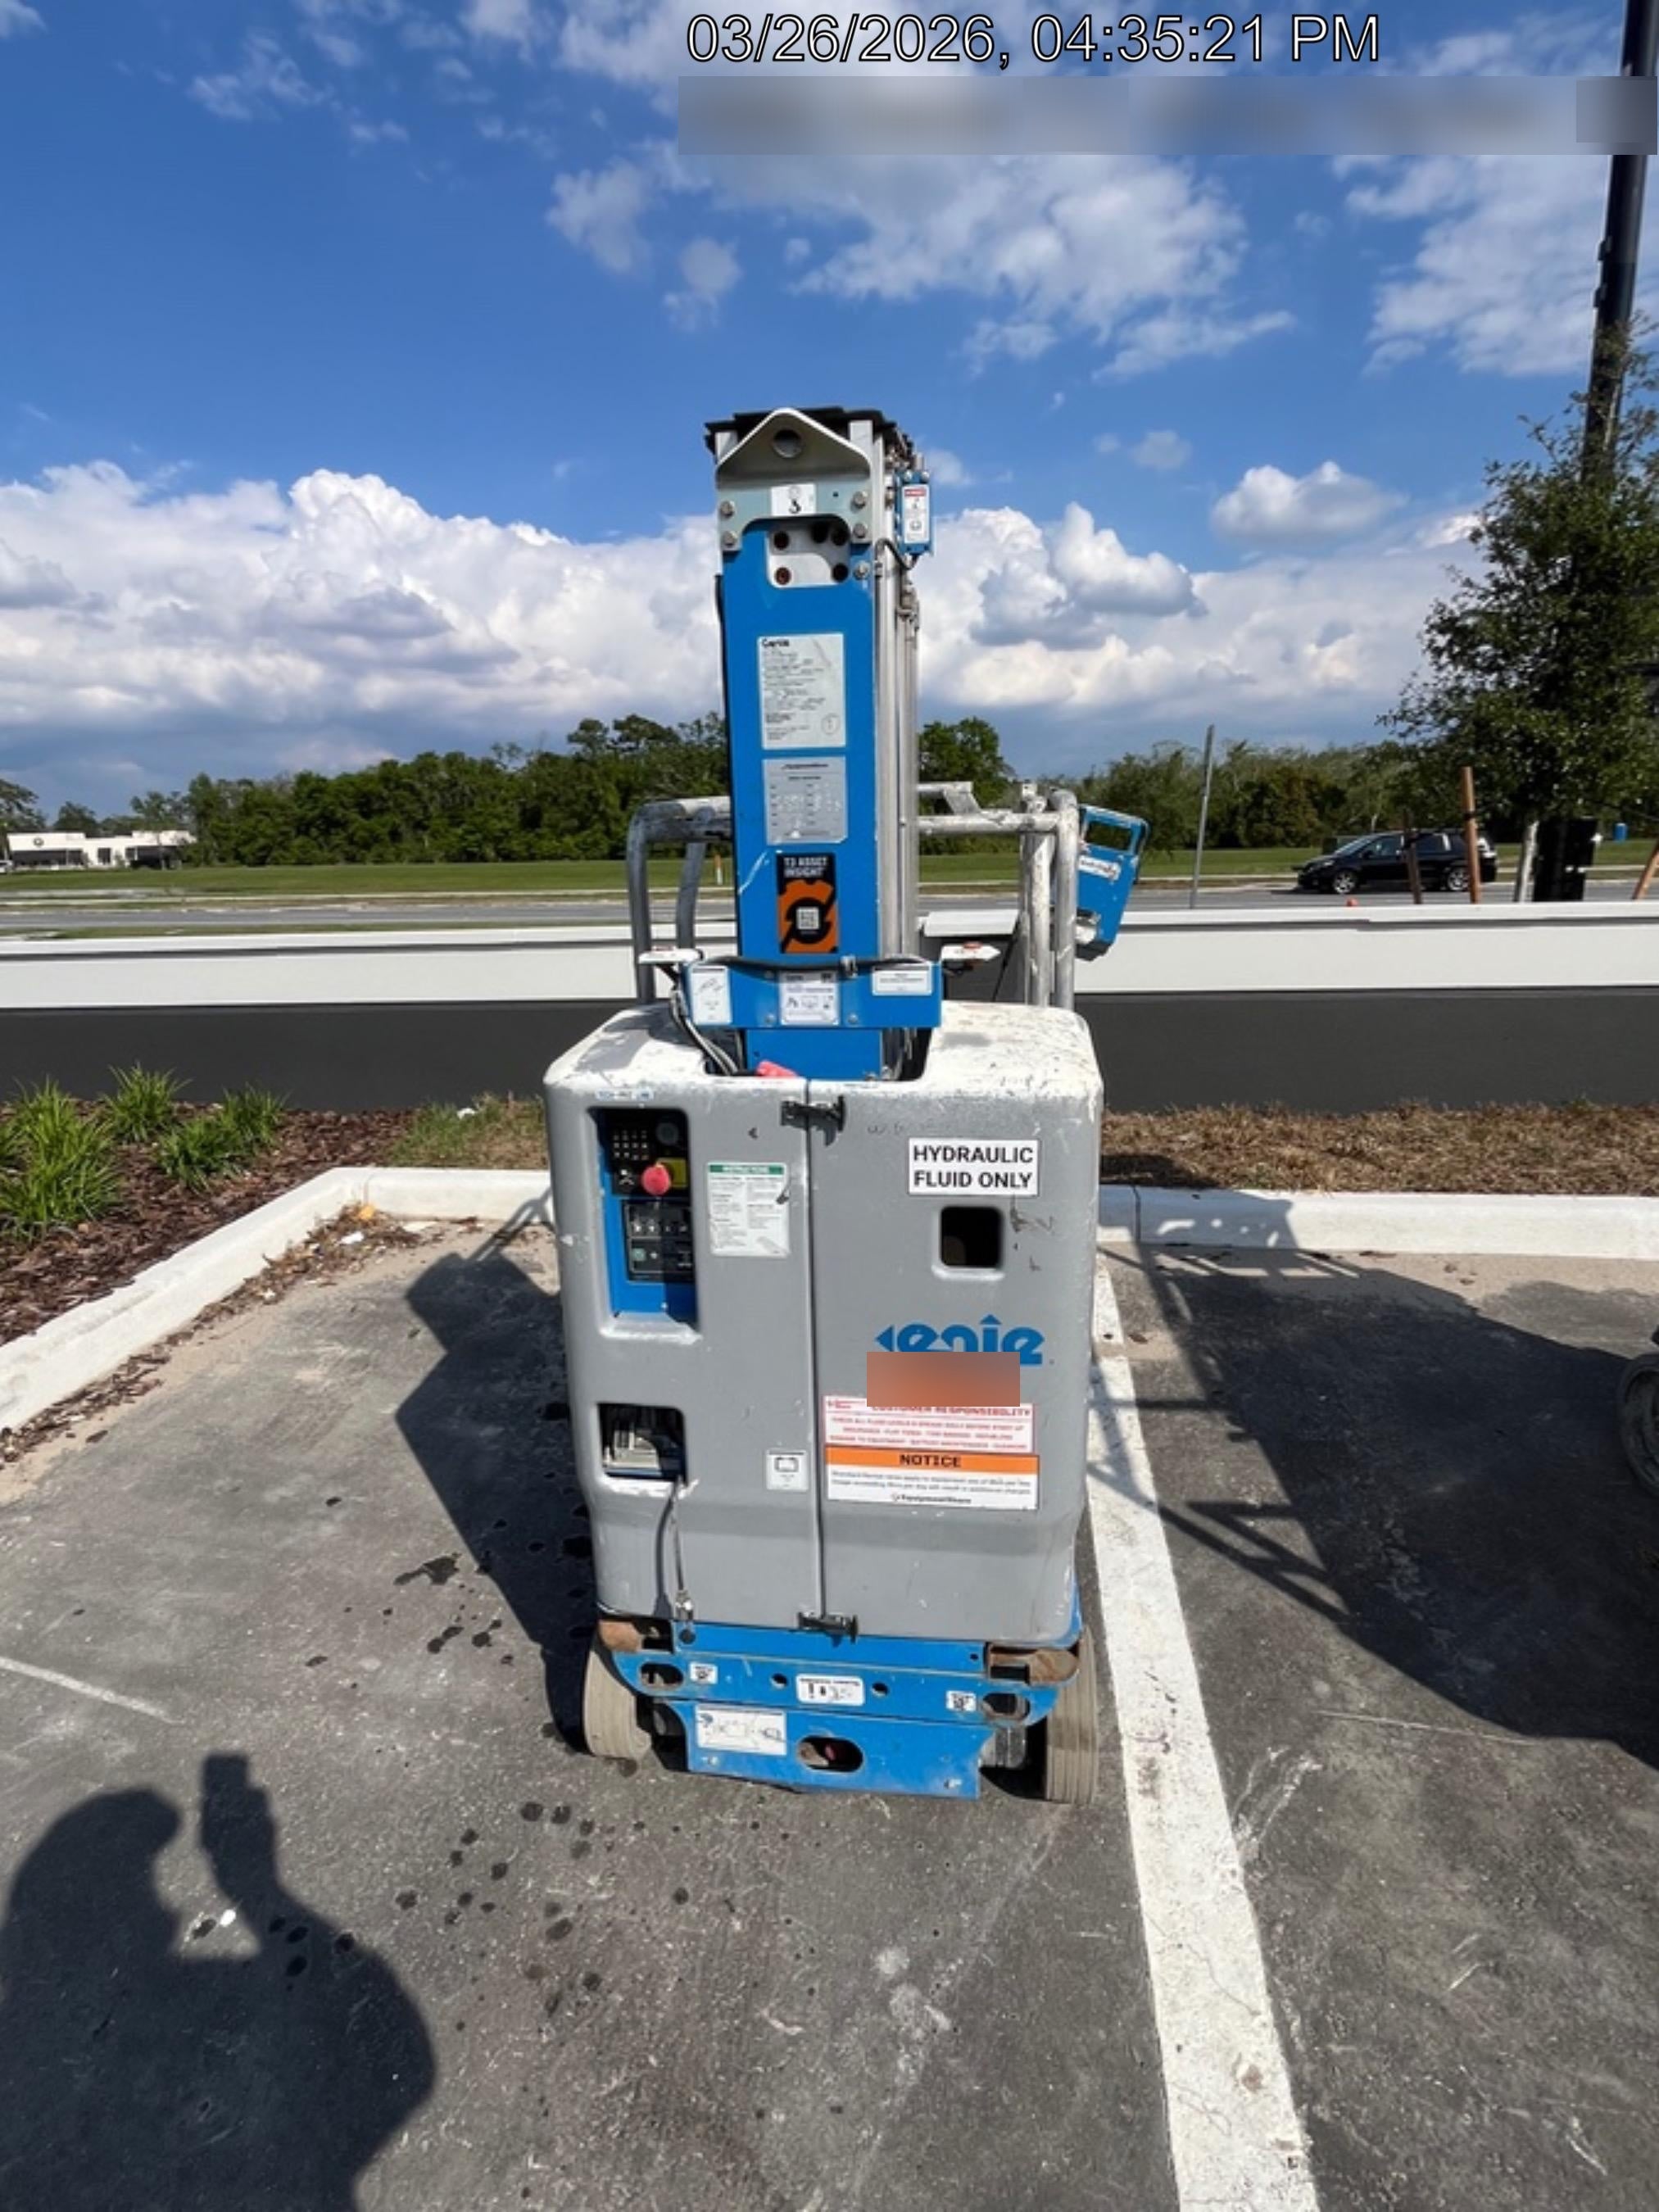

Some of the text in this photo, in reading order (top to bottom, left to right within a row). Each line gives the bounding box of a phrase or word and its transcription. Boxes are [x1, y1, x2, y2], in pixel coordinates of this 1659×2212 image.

[913, 1145, 1034, 1163] HYDRAULIC
[913, 1169, 1033, 1188] FLUID ONLY
[900, 1453, 962, 1468] NOTICE
